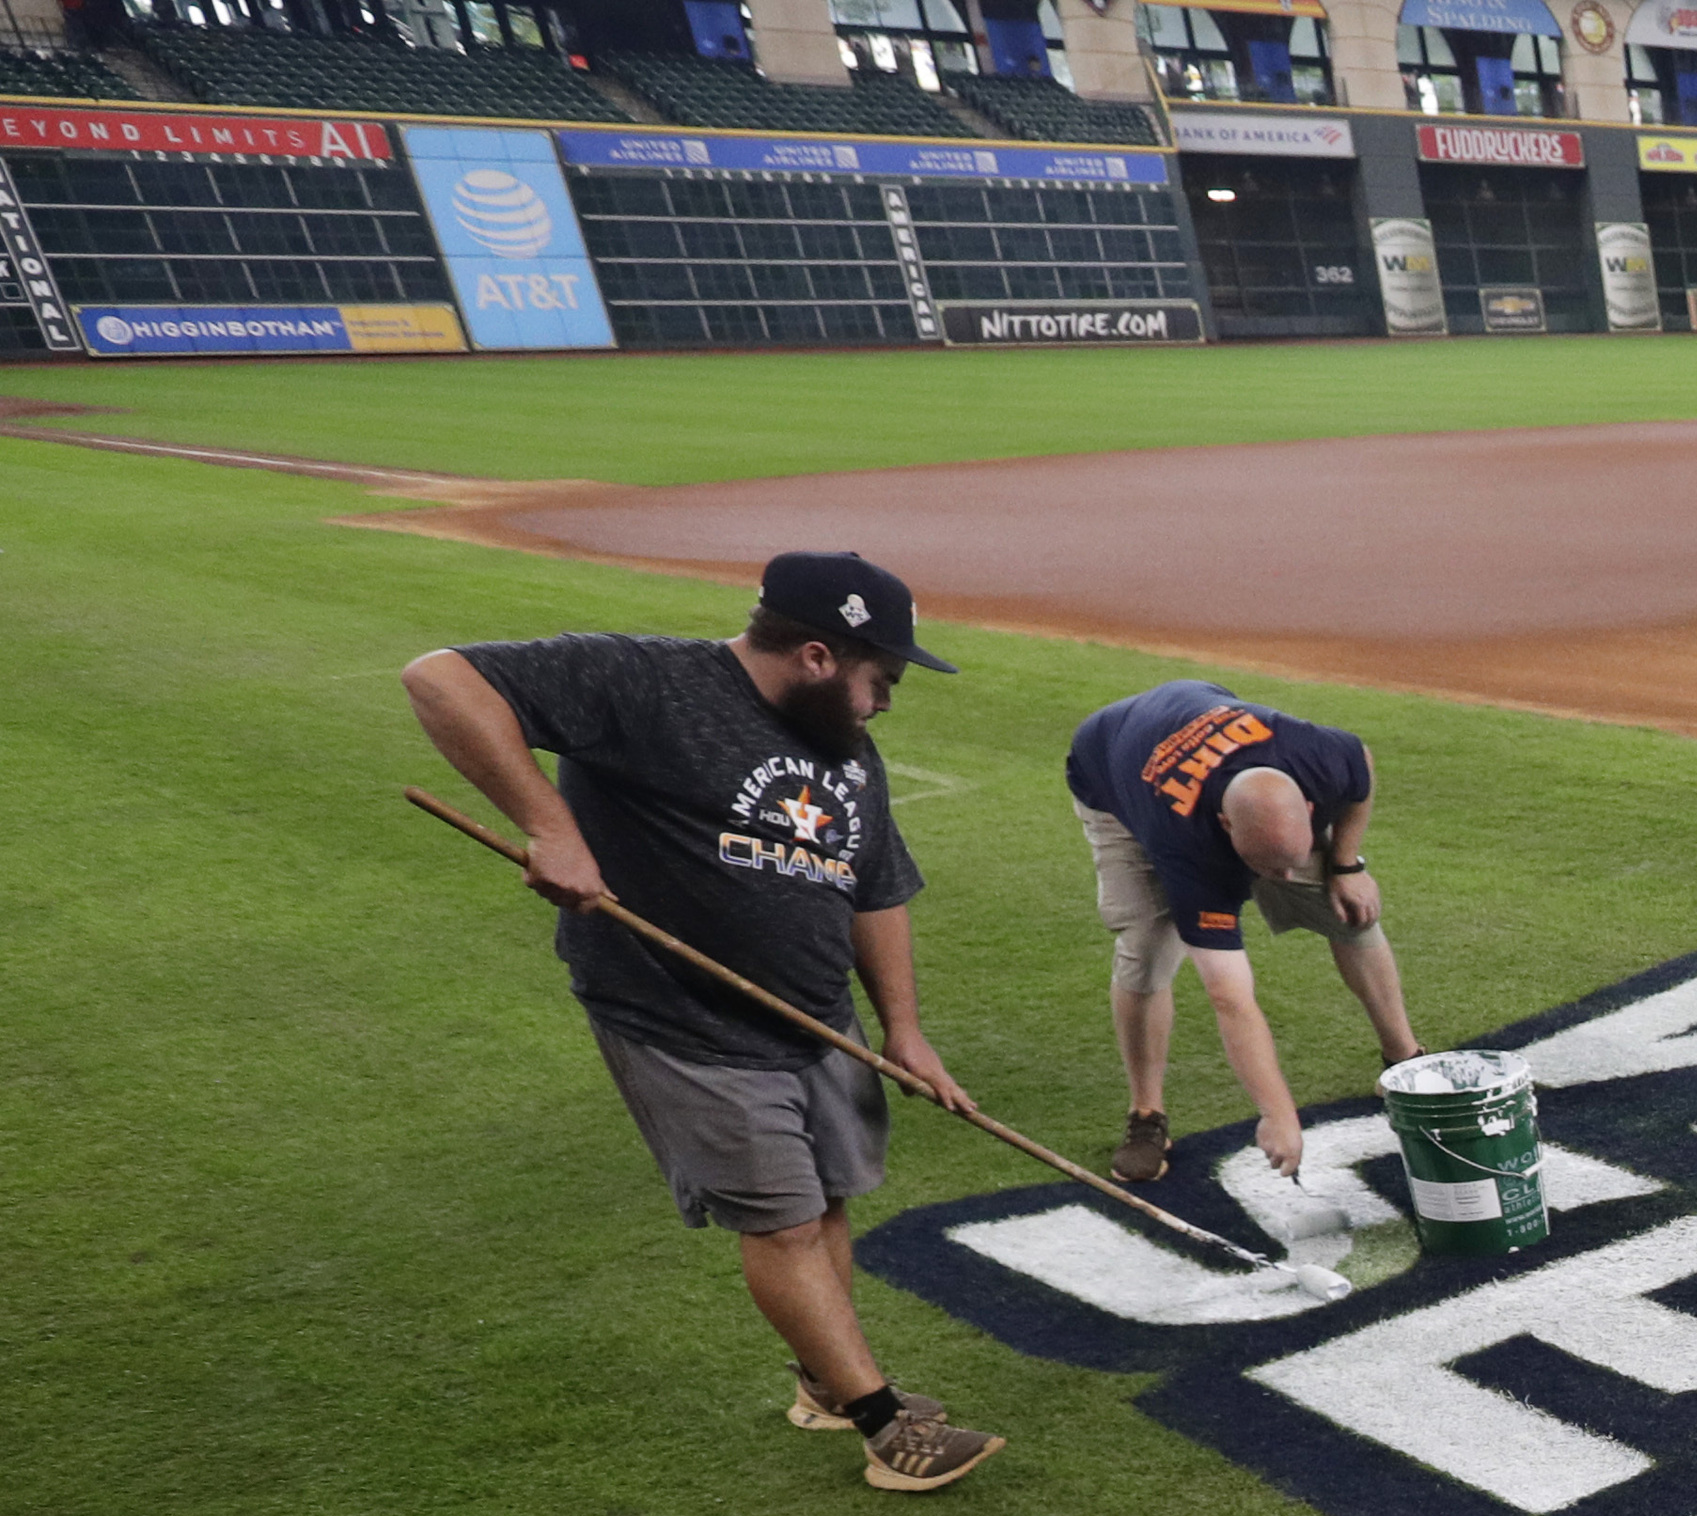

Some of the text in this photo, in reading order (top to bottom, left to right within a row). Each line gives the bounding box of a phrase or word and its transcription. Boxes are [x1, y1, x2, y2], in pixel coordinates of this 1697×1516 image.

[163, 125, 304, 149] LIMITS
[1220, 128, 1239, 141] OF
[1242, 129, 1312, 144] AMERICA
[1434, 127, 1565, 164] FUDDRUCKERS
[1383, 254, 1431, 271] WM
[1315, 265, 1354, 284] 362
[476, 274, 580, 311] AT&T
[131, 319, 336, 339] HIGGINBOTHAM
[981, 310, 1168, 339] NITTOTIRE.COM
